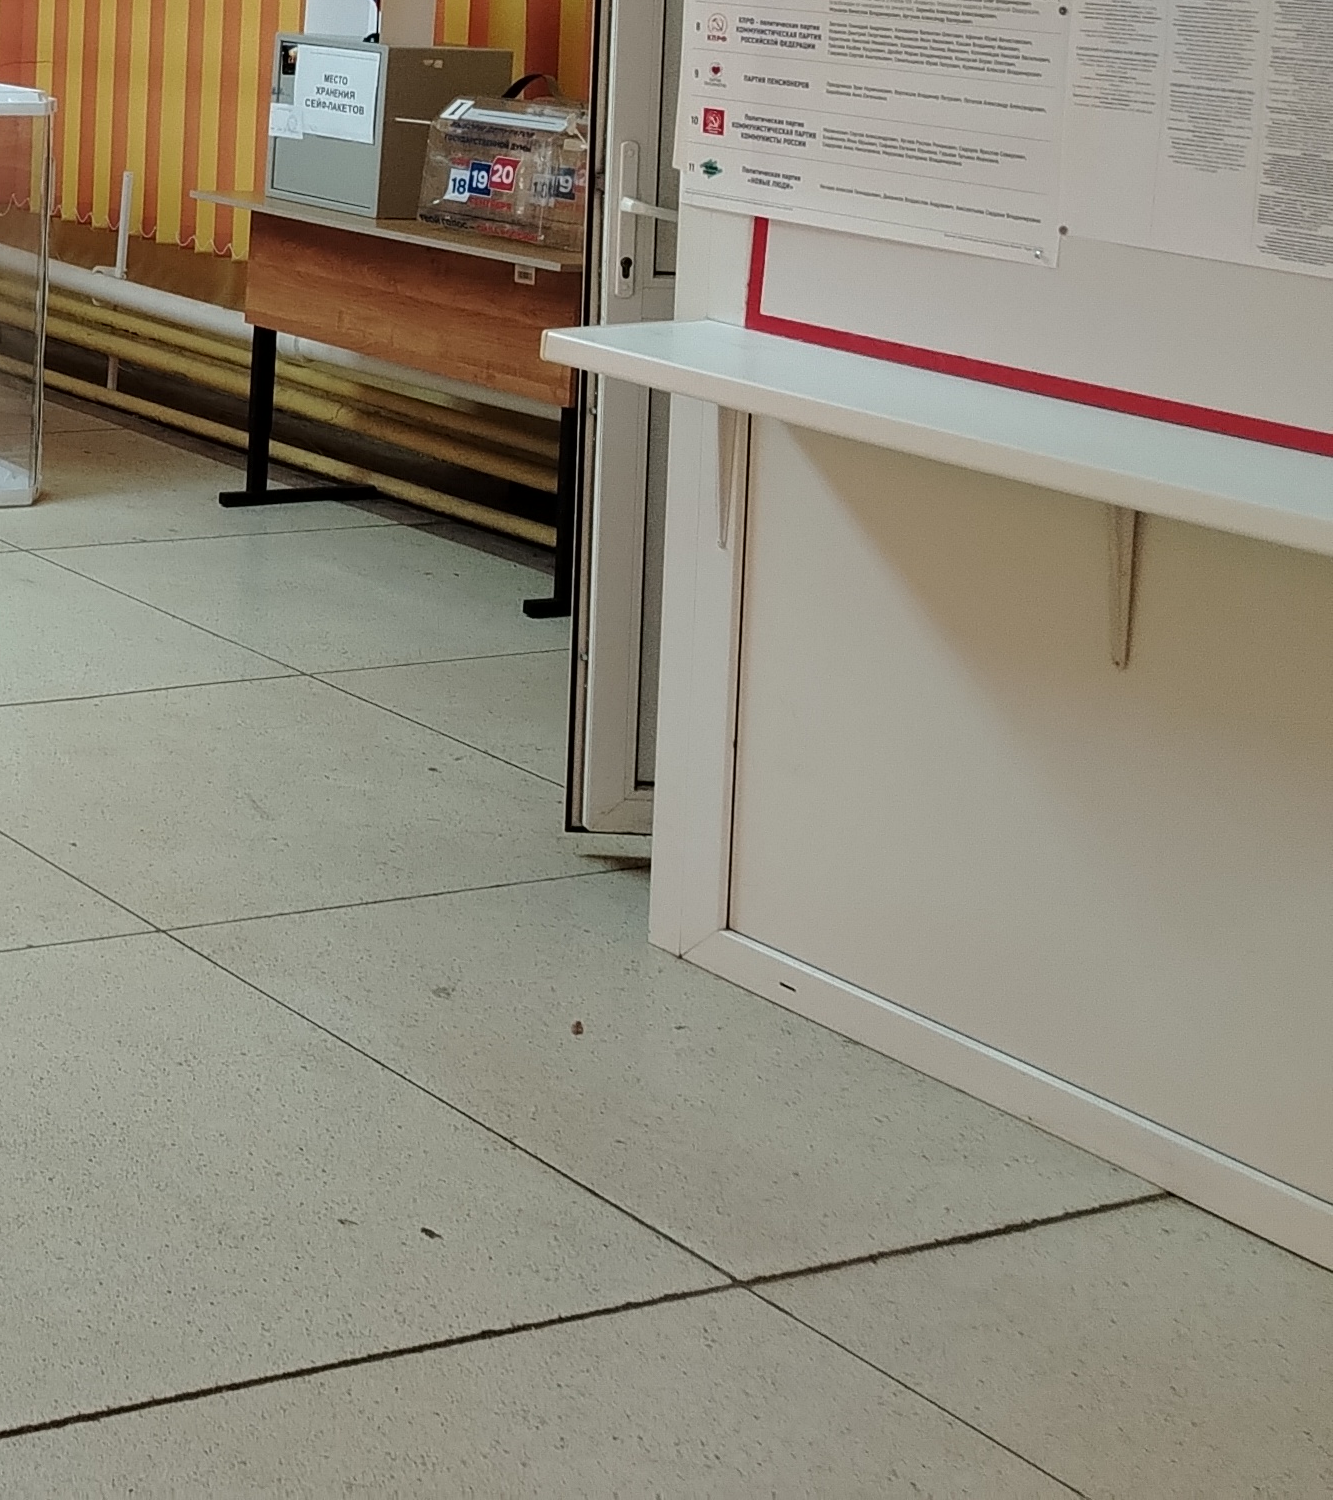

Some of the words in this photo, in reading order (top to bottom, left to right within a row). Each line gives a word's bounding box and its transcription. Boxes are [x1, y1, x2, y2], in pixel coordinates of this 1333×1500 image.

[707, 34, 727, 42] КПРФ
[324, 74, 348, 85] МЕСТО
[744, 74, 766, 83] ПАРТИЯ
[316, 87, 355, 100] ХРАНЕНИЯ
[305, 98, 364, 115] СЕЙФ-ПАКЕТОВ
[691, 116, 699, 125] 10
[689, 163, 695, 172] 11
[451, 177, 466, 195] 18
[472, 170, 487, 188] 19
[492, 164, 513, 184] 20
